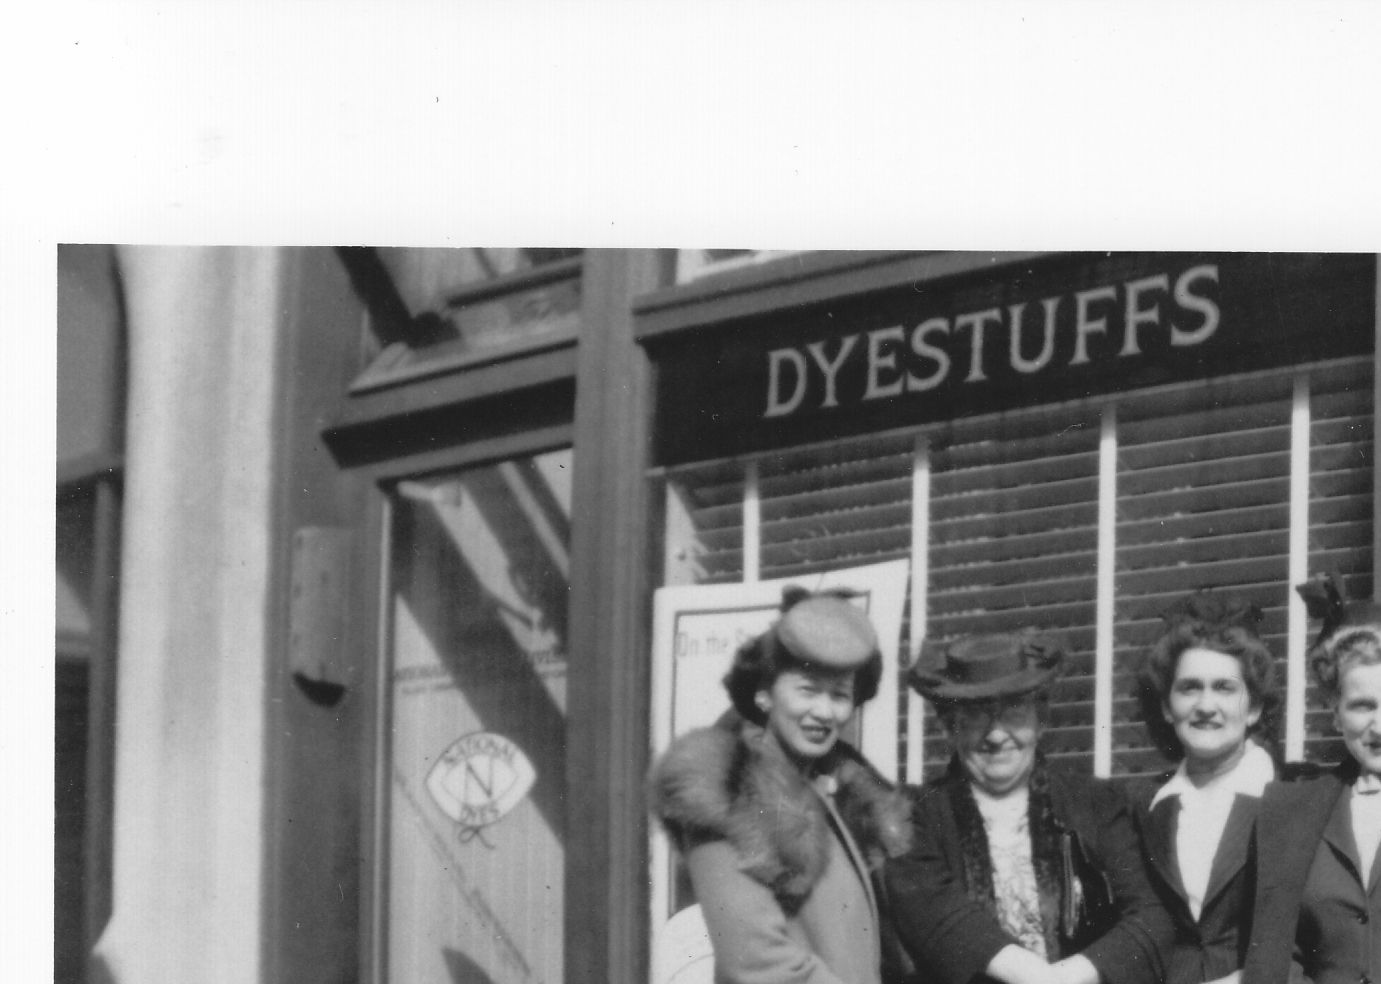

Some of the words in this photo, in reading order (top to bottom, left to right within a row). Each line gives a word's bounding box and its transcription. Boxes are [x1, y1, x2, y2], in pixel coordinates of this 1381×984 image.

[763, 264, 1220, 418] DYESTUFFS
[442, 737, 515, 767] NATIONAL
[464, 757, 494, 801] N
[460, 801, 500, 822] DYES
